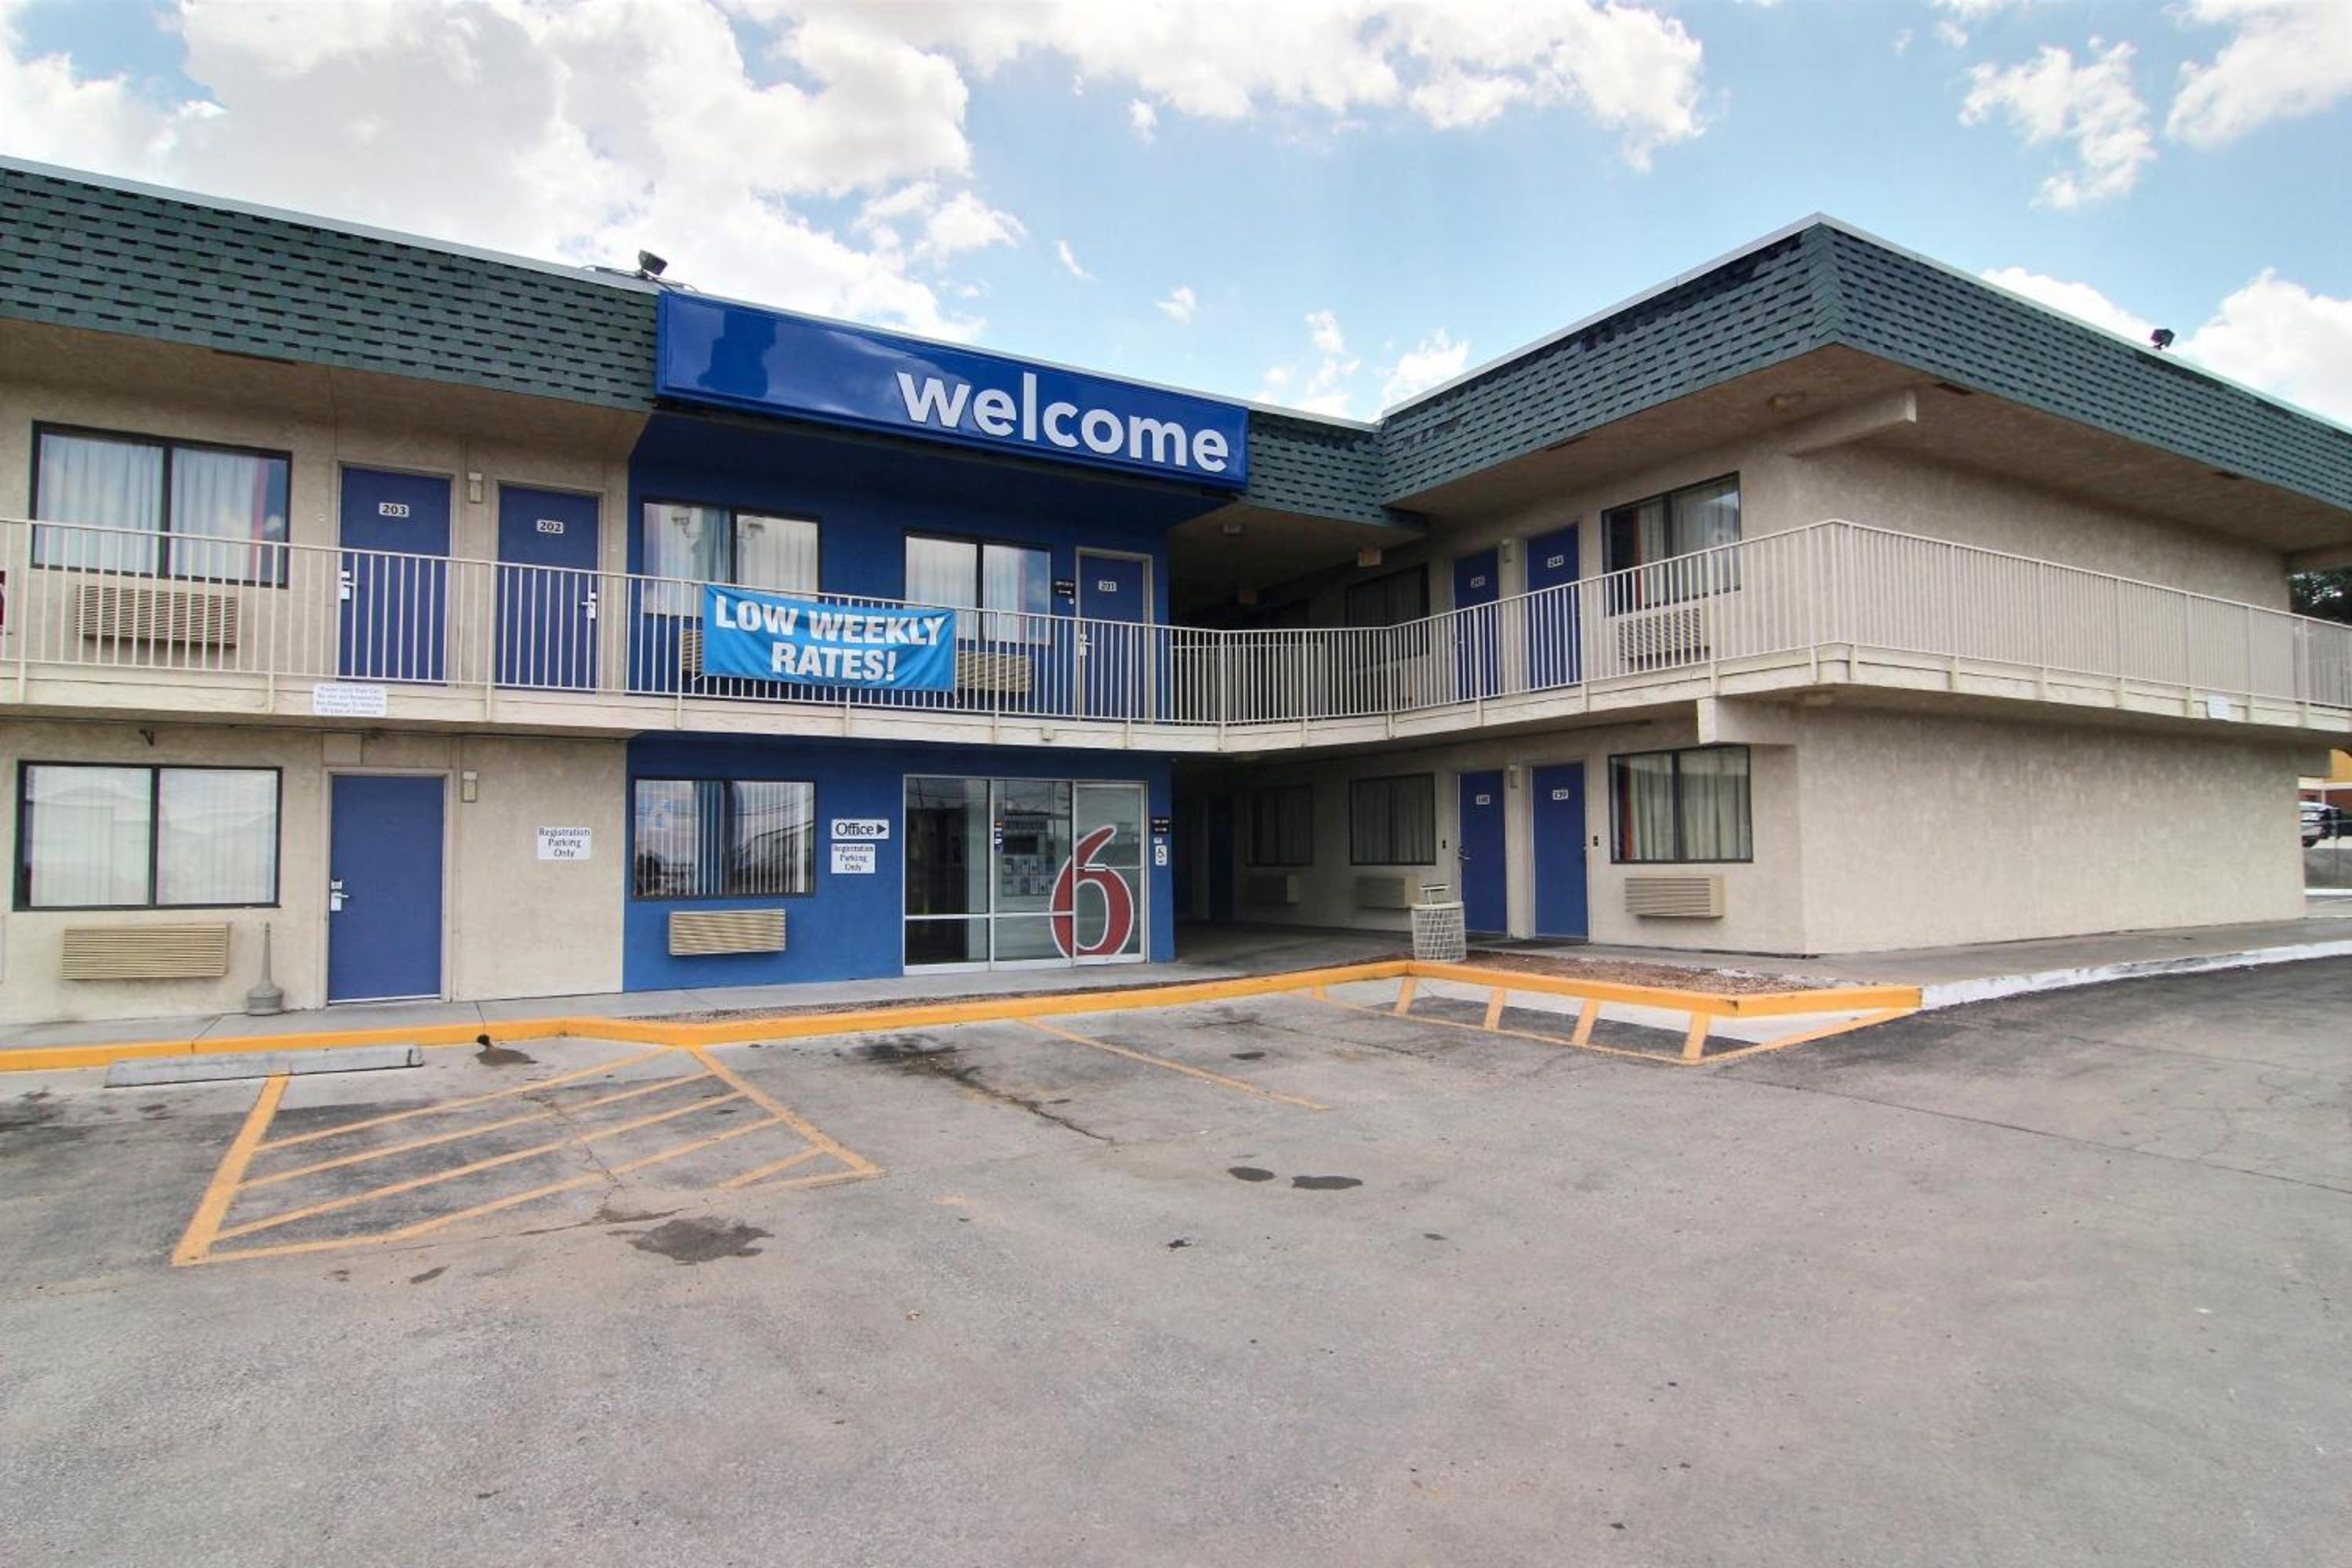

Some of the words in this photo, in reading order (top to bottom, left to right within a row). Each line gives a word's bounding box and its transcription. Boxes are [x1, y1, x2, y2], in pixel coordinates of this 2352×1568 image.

[896, 372, 1229, 472] welcome
[382, 504, 406, 515] 203
[539, 521, 562, 532] 202
[715, 594, 798, 636] LOW
[808, 610, 945, 645] WEEKLY
[771, 641, 897, 681] RATES!
[539, 827, 590, 837] Registration
[835, 822, 874, 836] Office
[548, 838, 582, 848] Parking
[553, 848, 575, 858] Only
[840, 854, 868, 862] Parking
[844, 863, 863, 872] Only
[1049, 825, 1134, 958] 6
